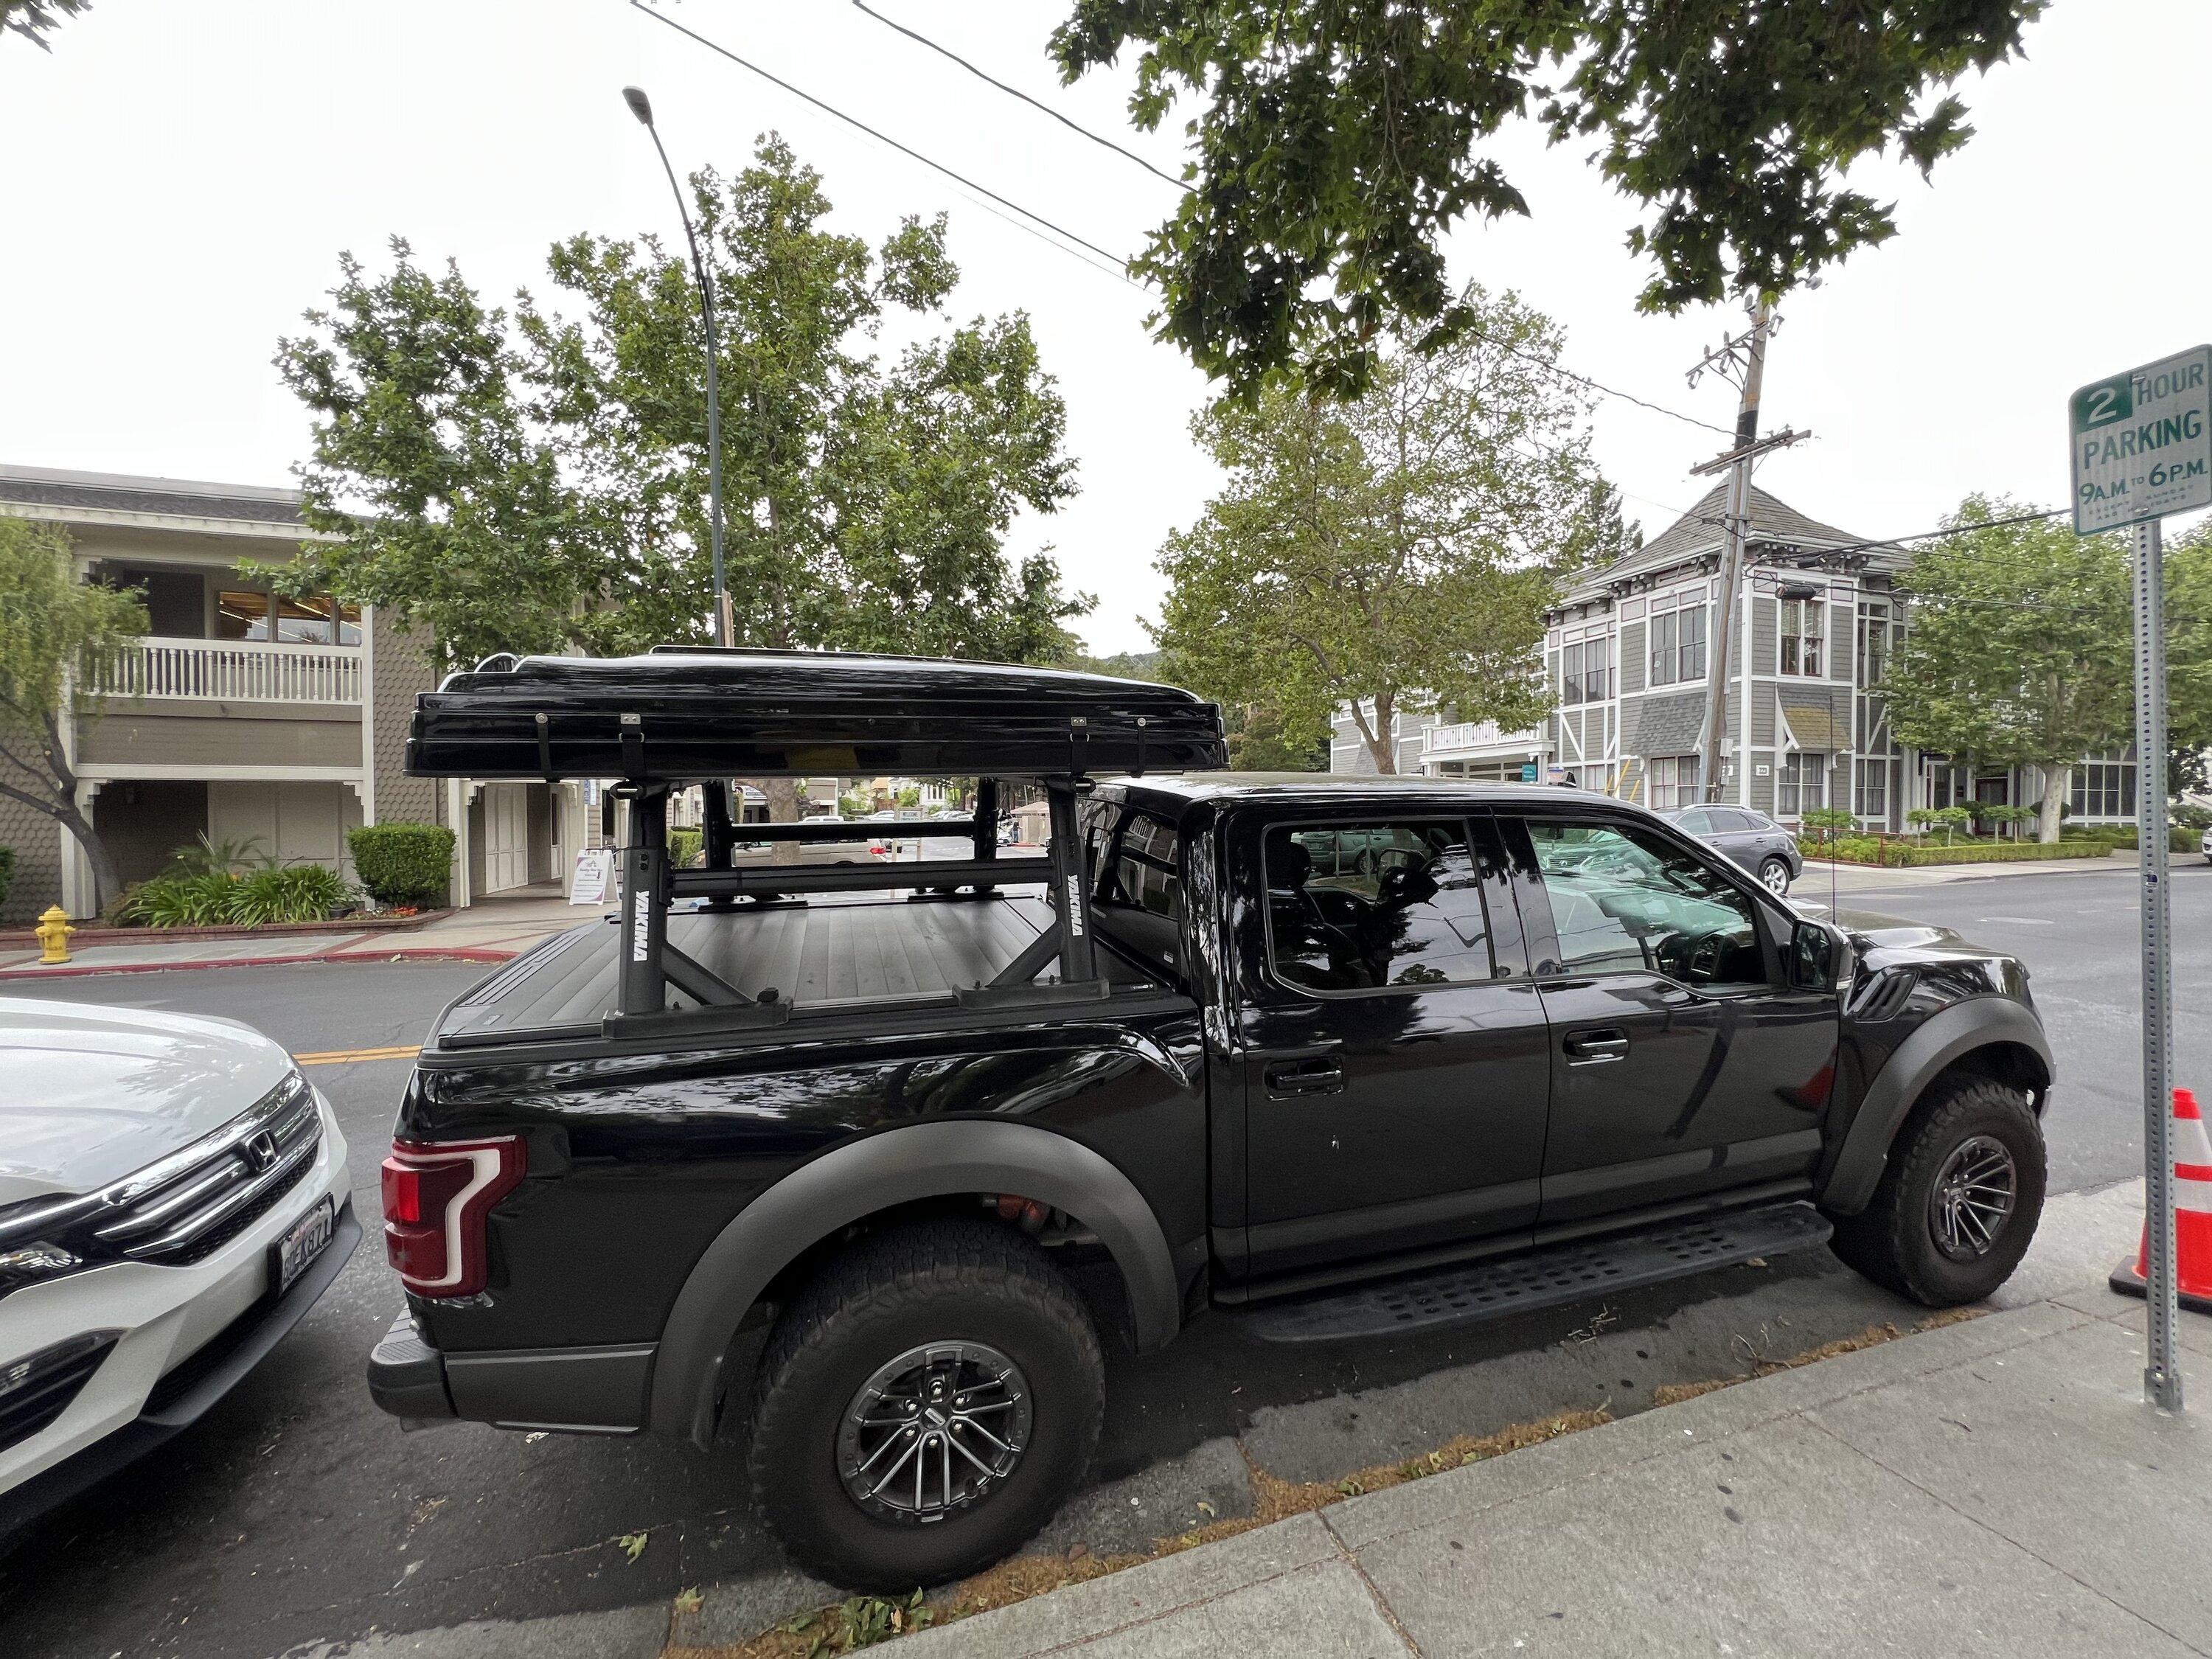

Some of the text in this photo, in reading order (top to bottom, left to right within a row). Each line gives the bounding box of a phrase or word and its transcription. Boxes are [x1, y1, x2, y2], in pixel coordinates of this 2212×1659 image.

[2087, 363, 2204, 425] 2 HOUR
[2083, 409, 2202, 470] PARKING
[634, 891, 650, 961] YAKIMA
[1067, 874, 1083, 936] YAKIMA
